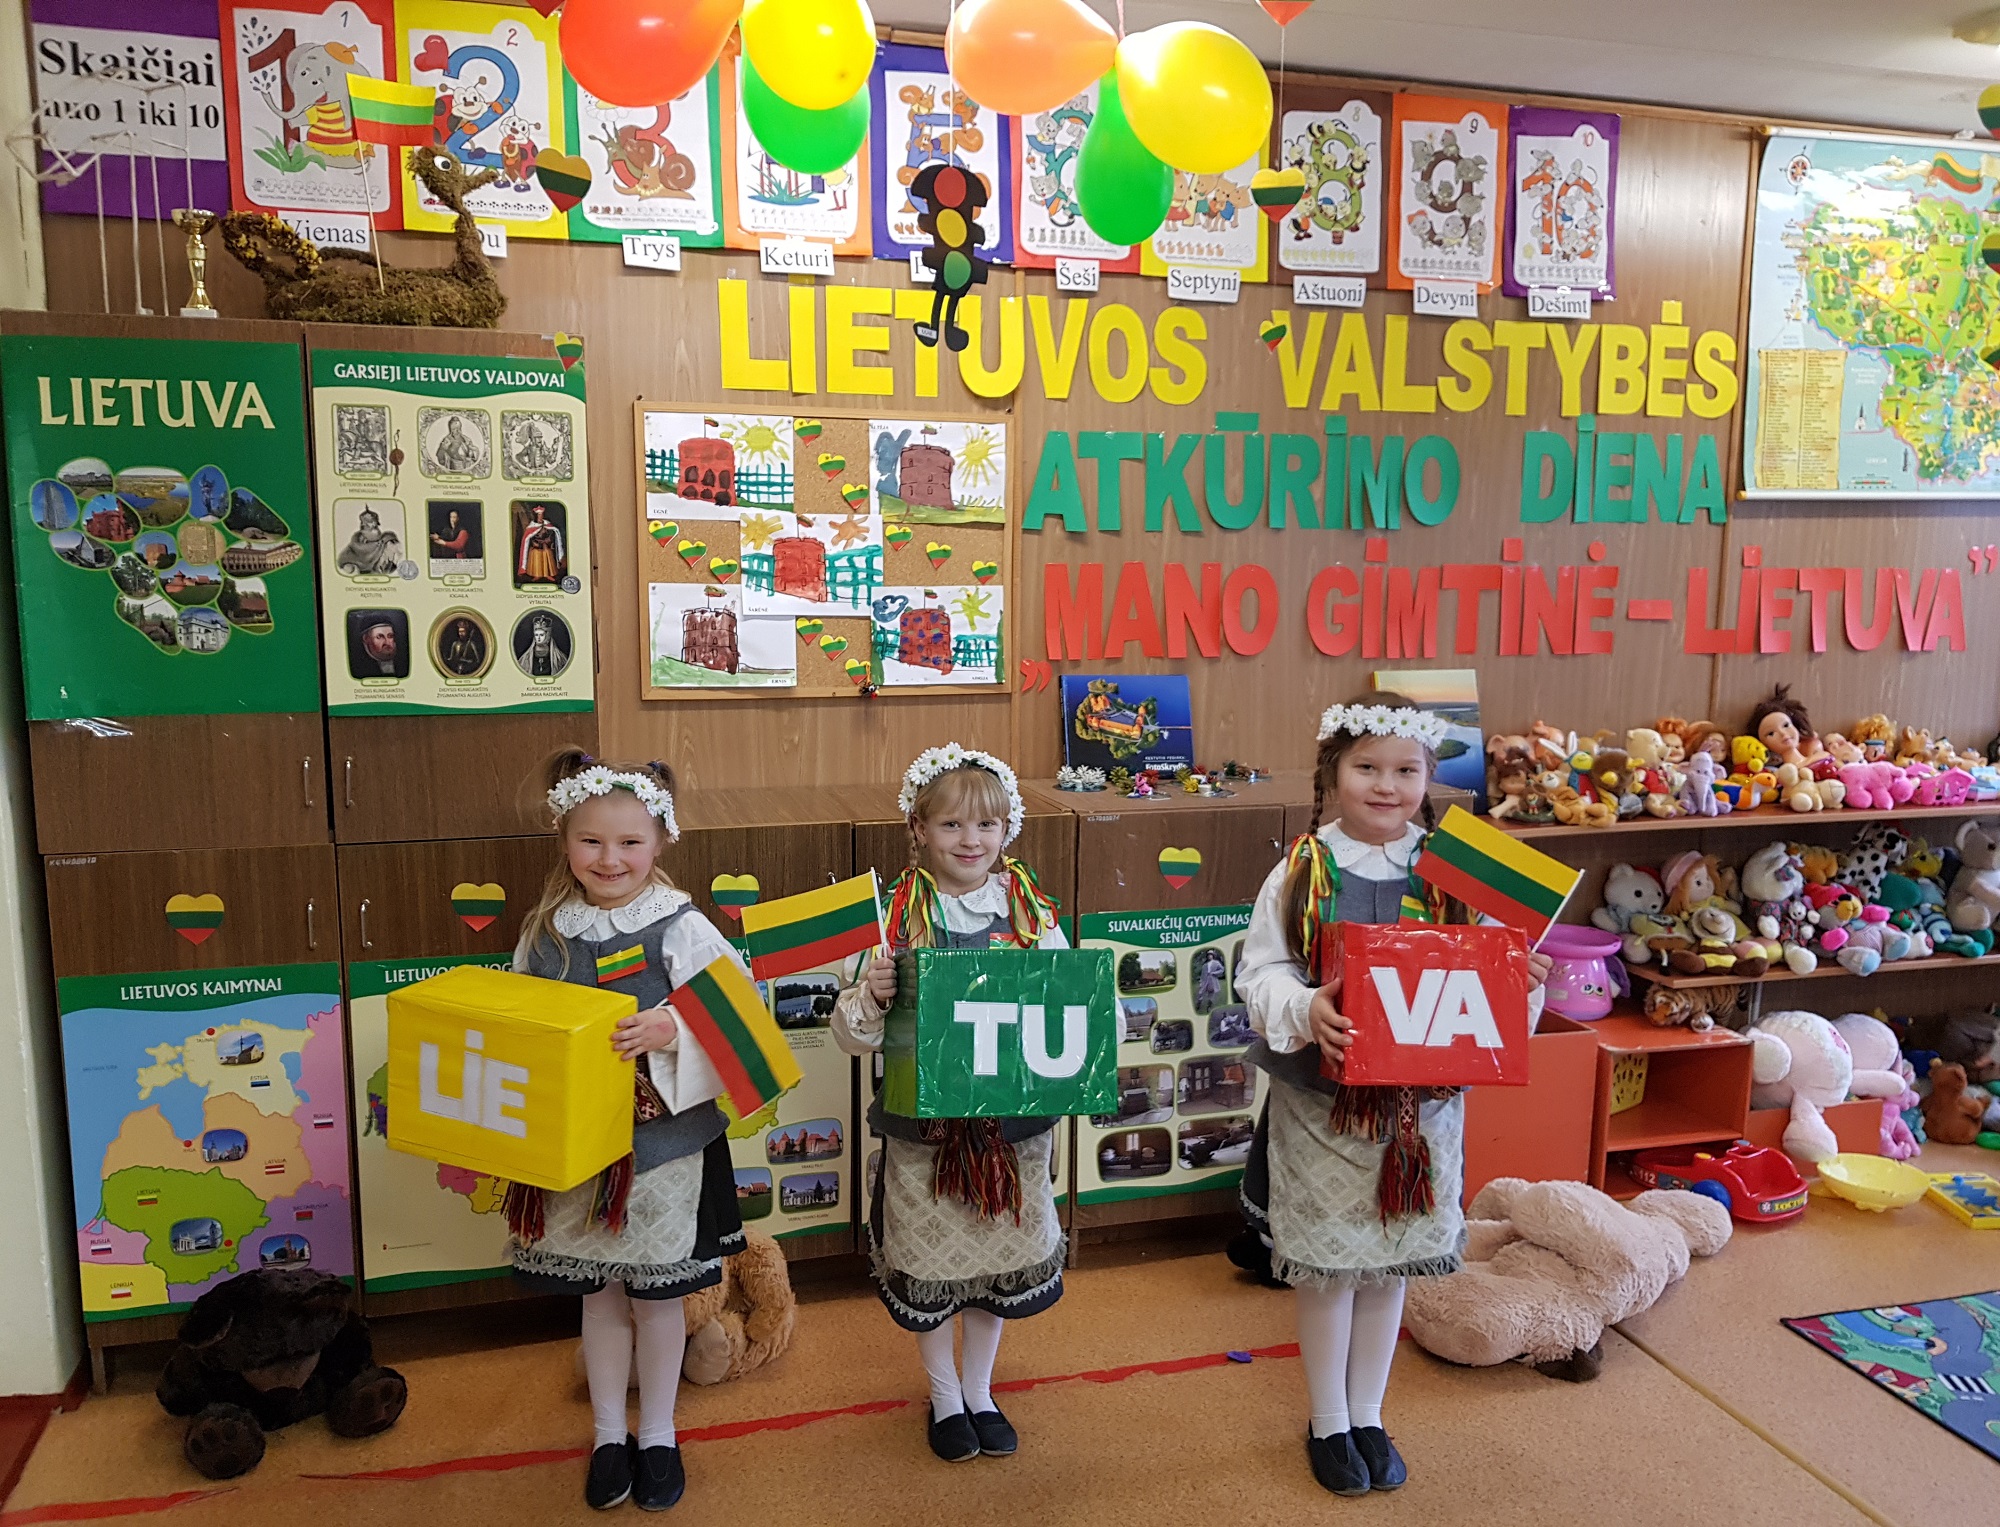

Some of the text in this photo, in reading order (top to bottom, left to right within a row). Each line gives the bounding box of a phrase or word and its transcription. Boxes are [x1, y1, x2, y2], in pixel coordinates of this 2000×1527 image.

[39, 38, 216, 87] Skaičiai
[115, 99, 125, 123] 1
[139, 100, 178, 126] iki
[189, 105, 220, 129] 10
[624, 236, 676, 262] Trys
[764, 246, 830, 268] Keturi
[1058, 262, 1097, 288] Šeši
[1169, 268, 1238, 295] Septyni
[1295, 280, 1363, 303] Aštuoni
[1416, 286, 1476, 310] Devyni
[1530, 294, 1588, 314] Dešimt
[718, 278, 1739, 418] LIETUVOS VALSTYBĖS
[334, 363, 566, 388] GARSIEJI LIETUVOS VALDOVAI
[38, 376, 276, 430] LIETUVA
[1108, 912, 1250, 933] SUVALKIEČIŲ GYVENIMAS
[1159, 930, 1201, 944] SENIAU
[120, 977, 282, 1001] LIETUVOS KAIMYNAI
[1368, 966, 1504, 1048] VA
[953, 1001, 1088, 1079] TU
